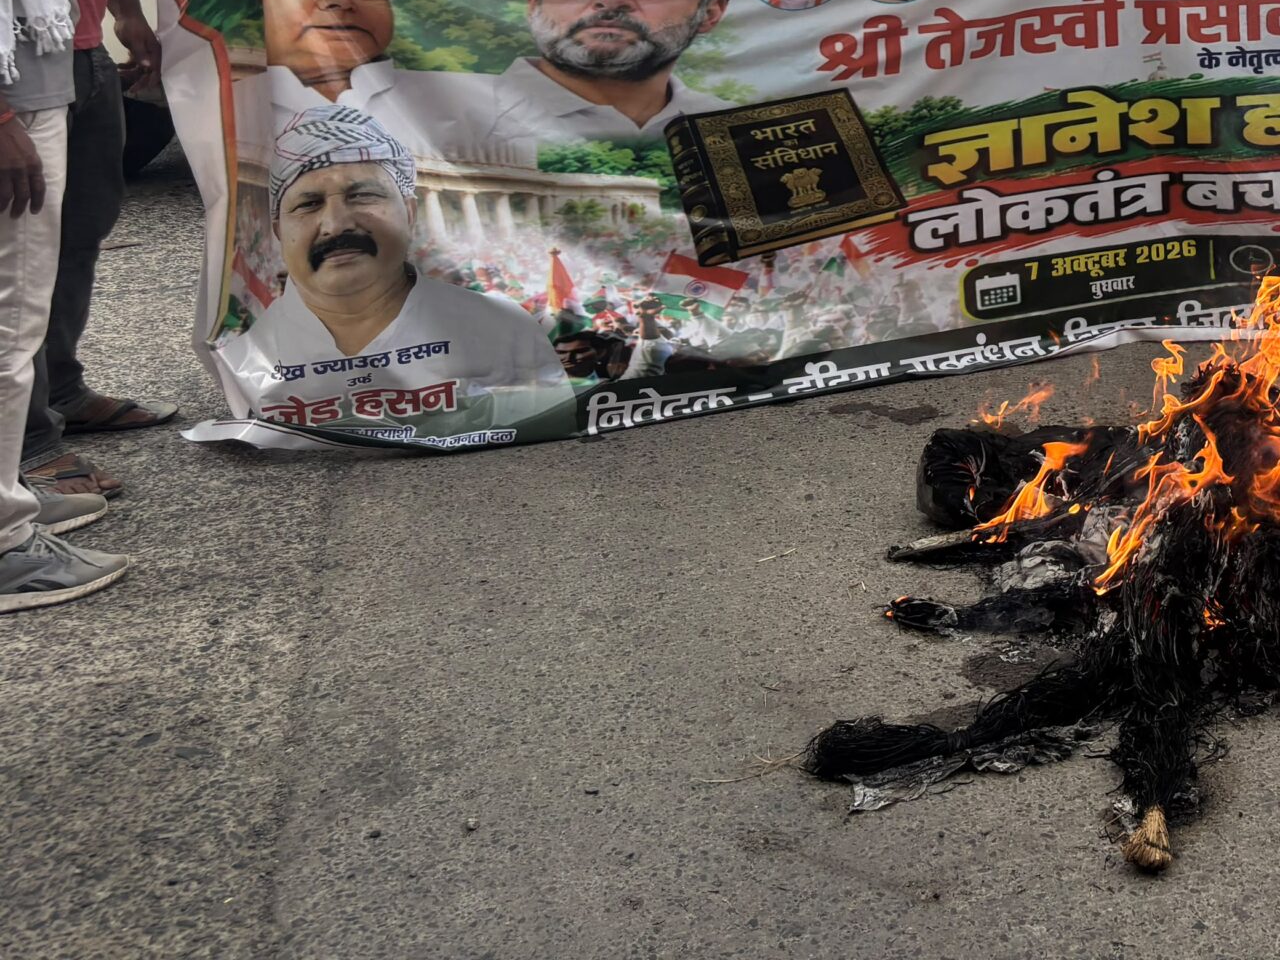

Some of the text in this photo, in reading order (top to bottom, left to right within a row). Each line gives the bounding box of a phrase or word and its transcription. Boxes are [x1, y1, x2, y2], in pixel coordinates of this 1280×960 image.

[815, 14, 910, 82] श्री
[1197, 47, 1222, 70] के
[750, 118, 817, 143] भारत
[923, 90, 1222, 185] ज्ञानेश
[750, 141, 839, 171] संविधान
[908, 170, 1170, 250] लोकतंत्र
[1025, 239, 1197, 281] 7 अक्टूबर 2026
[311, 351, 391, 375] ज्याउल
[397, 340, 450, 365] हसन
[351, 381, 456, 417] हसन
[489, 430, 515, 441] दल
